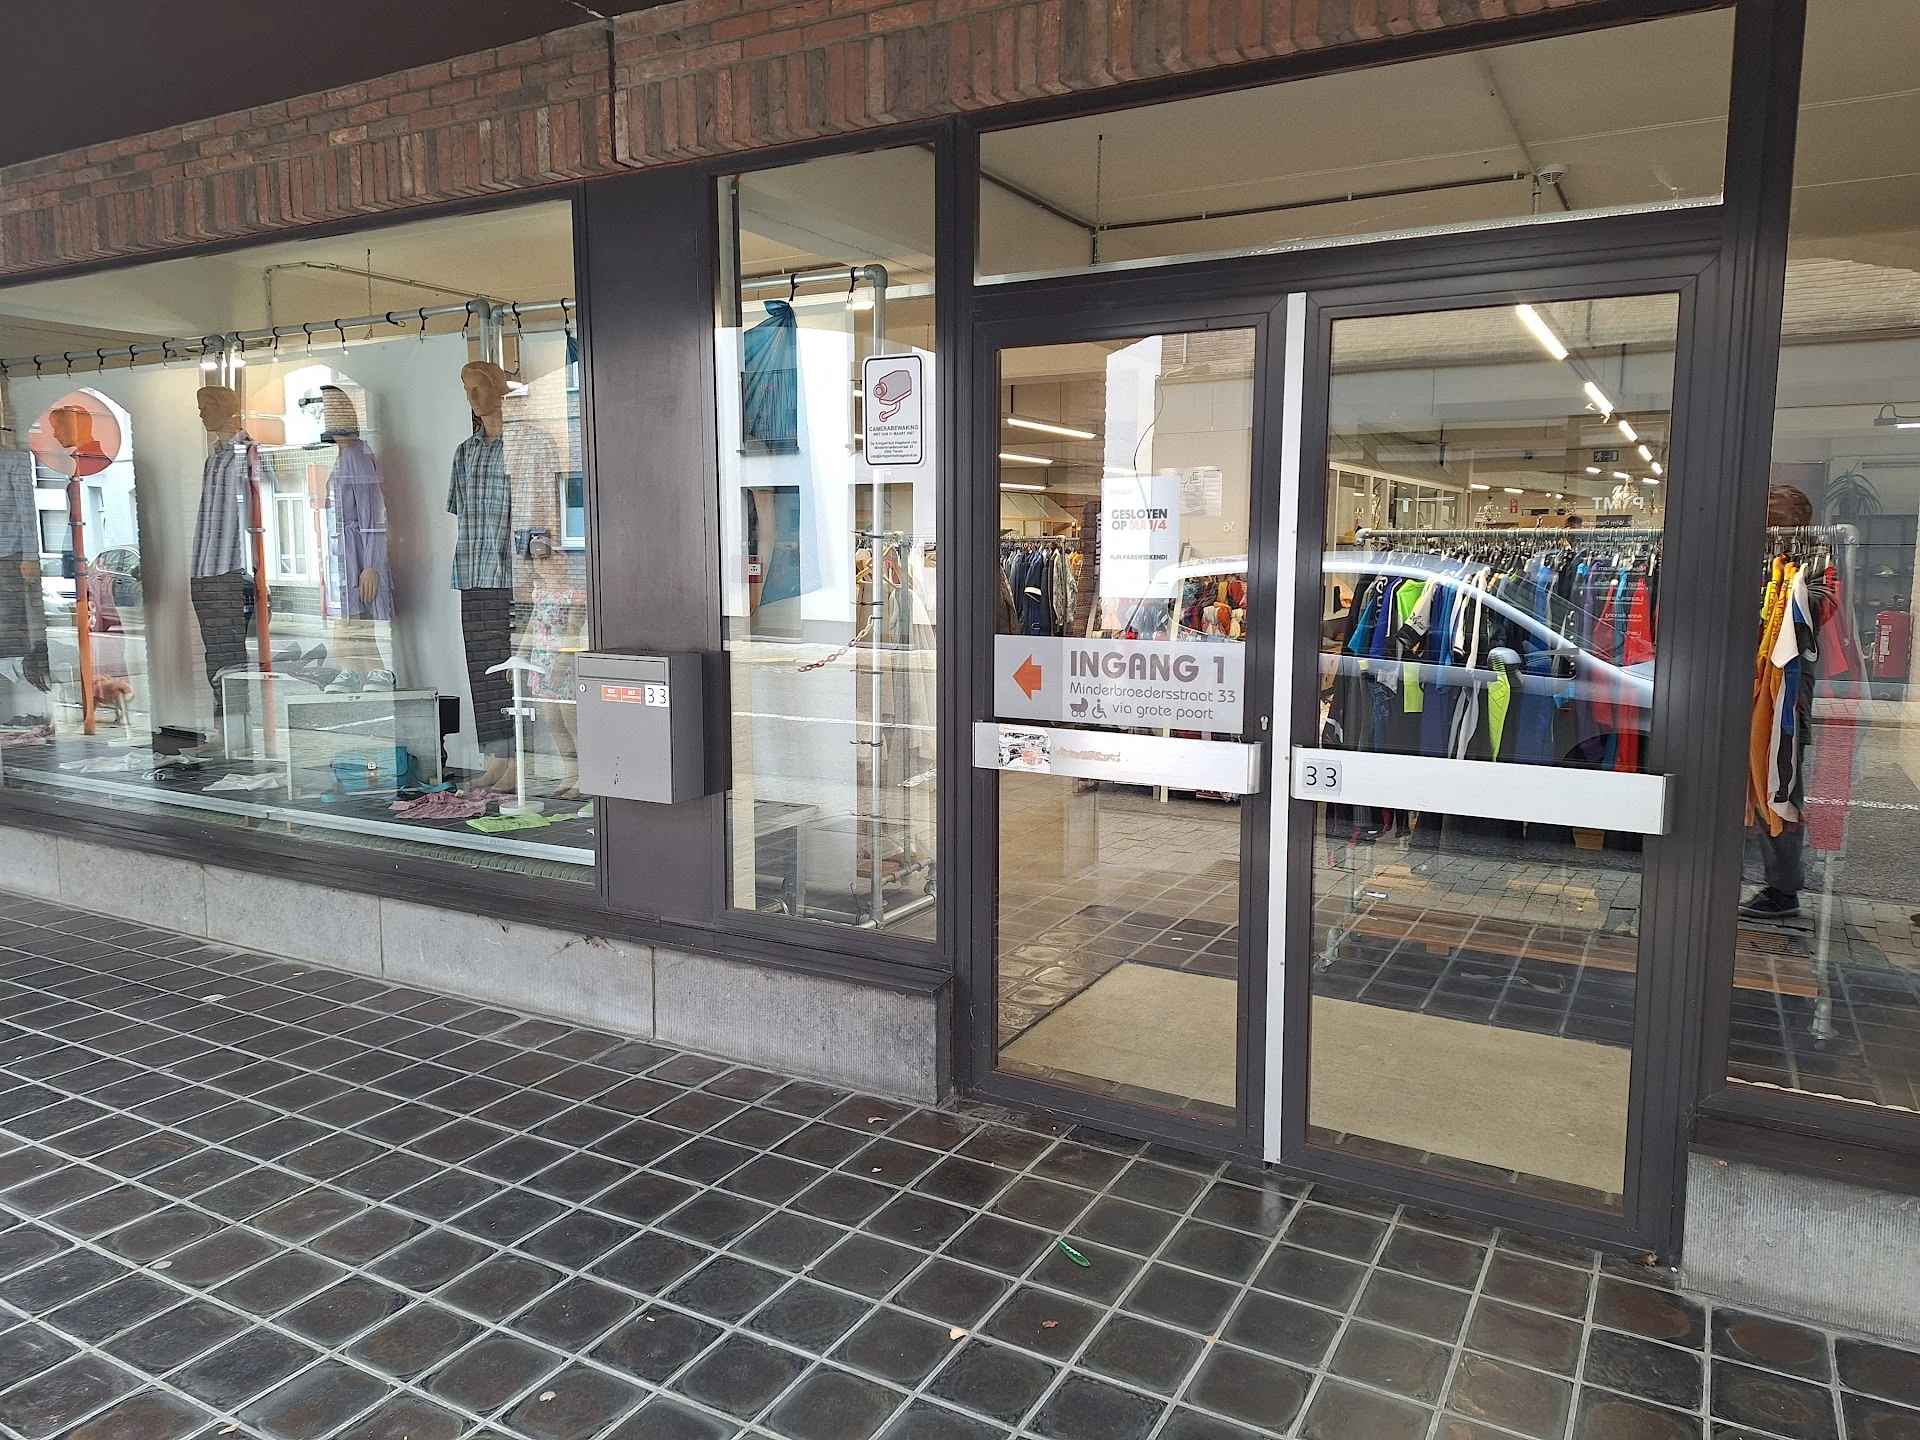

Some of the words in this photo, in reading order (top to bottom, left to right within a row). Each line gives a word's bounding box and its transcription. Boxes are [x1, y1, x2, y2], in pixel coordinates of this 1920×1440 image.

[1111, 508, 1168, 520] GESLOTEN
[1111, 520, 1127, 531] OP
[1129, 520, 1147, 530] MA
[1149, 519, 1168, 532] 1/4
[1070, 650, 1200, 683] INGANG
[1213, 656, 1226, 684] 1
[648, 688, 666, 704] 33
[1070, 681, 1213, 703] Minderbroedersstraat
[1217, 689, 1236, 703] 33
[1112, 702, 1132, 715] via
[1136, 702, 1172, 719] grote
[1176, 705, 1214, 720] poort
[1305, 764, 1338, 789] 33
